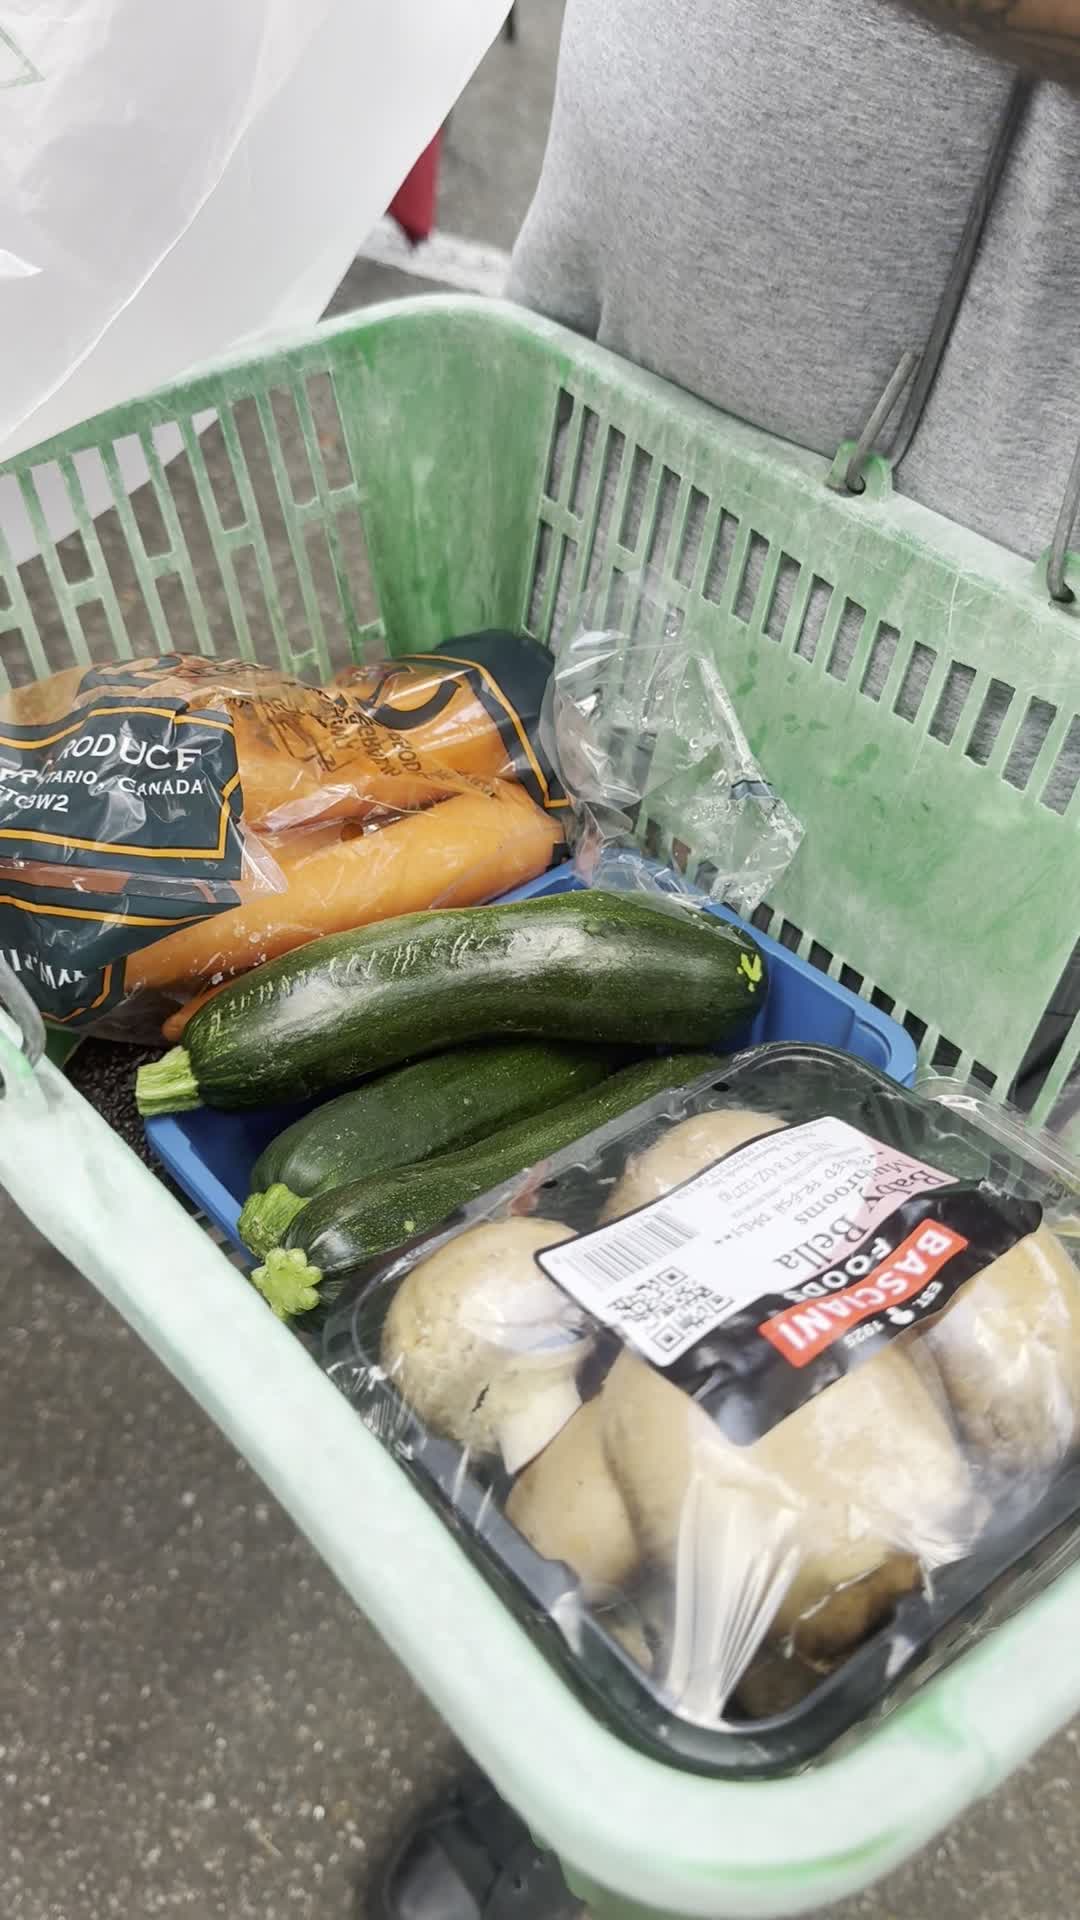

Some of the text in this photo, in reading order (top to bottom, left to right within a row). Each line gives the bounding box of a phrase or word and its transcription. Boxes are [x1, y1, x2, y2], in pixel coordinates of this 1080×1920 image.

[118, 776, 204, 796] CANADA
[793, 1159, 911, 1225] Muhrooms
[860, 1169, 945, 1213] Baby
[774, 1215, 872, 1270] Bella
[783, 1236, 893, 1303] FOODS
[777, 1229, 953, 1351] BASCIANI
